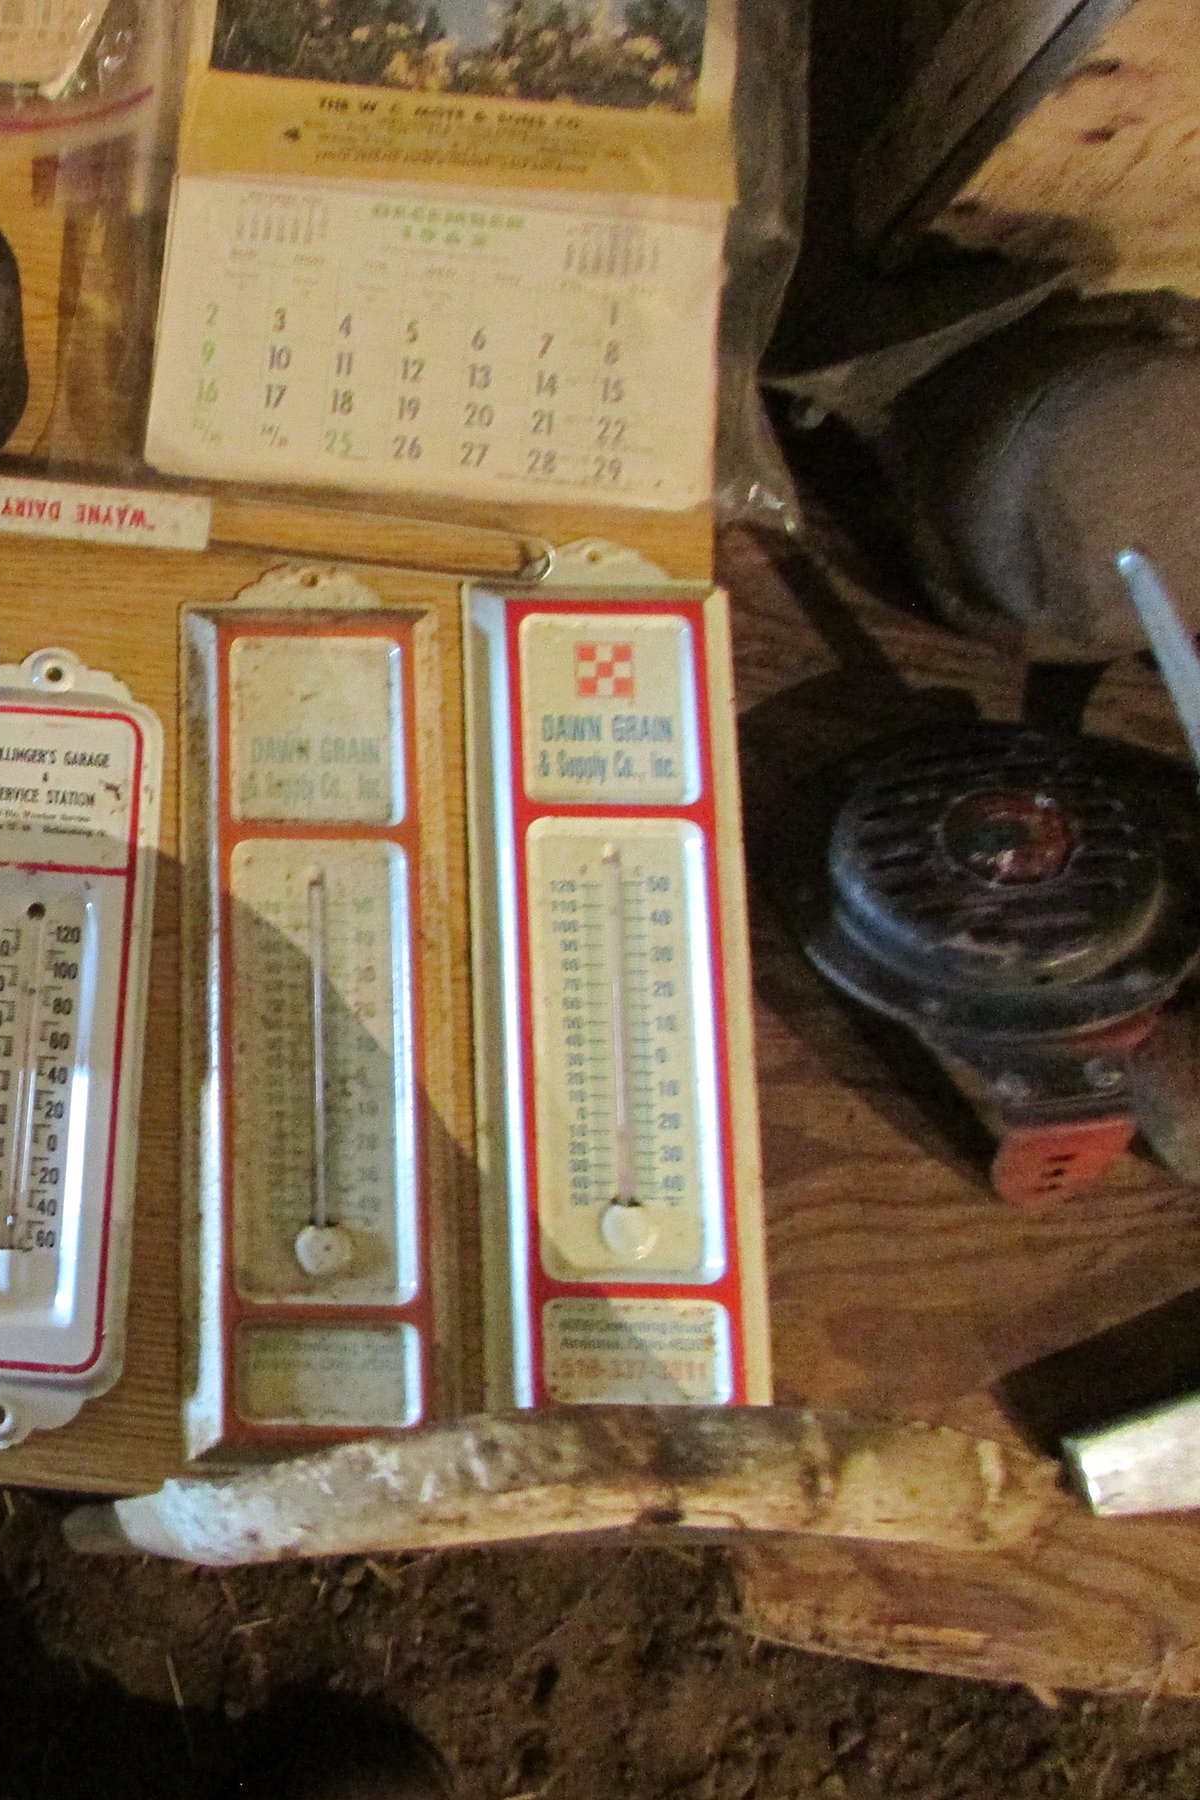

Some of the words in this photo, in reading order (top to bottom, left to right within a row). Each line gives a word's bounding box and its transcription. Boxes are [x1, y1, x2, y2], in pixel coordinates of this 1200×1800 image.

[372, 202, 527, 231] DECEMBER
[272, 306, 288, 333] 3
[338, 312, 352, 338] 4
[406, 318, 420, 344] 5
[470, 326, 488, 351] 6
[537, 331, 555, 359] 7
[604, 339, 621, 366] 8
[202, 339, 216, 363] 9
[268, 344, 293, 371] 10
[335, 350, 353, 378] 11
[401, 355, 426, 384] 12
[467, 361, 493, 391] 13
[535, 369, 559, 399] 14
[601, 376, 625, 404] 15
[195, 377, 219, 403] 16
[264, 383, 288, 409] 17
[330, 387, 354, 416] 18
[398, 394, 422, 422] 19
[463, 400, 495, 428] 20
[530, 407, 555, 437] 21
[596, 415, 626, 446] 22
[323, 429, 353, 456] 25
[392, 434, 422, 462] 26
[459, 440, 490, 468] 27
[527, 448, 558, 475] 28
[592, 455, 623, 481] 29
[0, 496, 62, 522] DAIRY
[612, 713, 673, 742] GRAIN
[63, 751, 111, 769] GARAGE
[557, 749, 606, 784] Supply
[41, 771, 49, 783] &
[46, 788, 96, 808] STATION
[55, 925, 82, 945] 120
[53, 959, 79, 980] 100
[52, 996, 73, 1016] 80
[49, 1030, 71, 1050] 60
[48, 1066, 69, 1085] 40
[44, 1099, 65, 1120] 20
[46, 1133, 58, 1153] 0
[39, 1166, 60, 1186] 20
[37, 1198, 58, 1217] 40
[35, 1229, 56, 1249] 60
